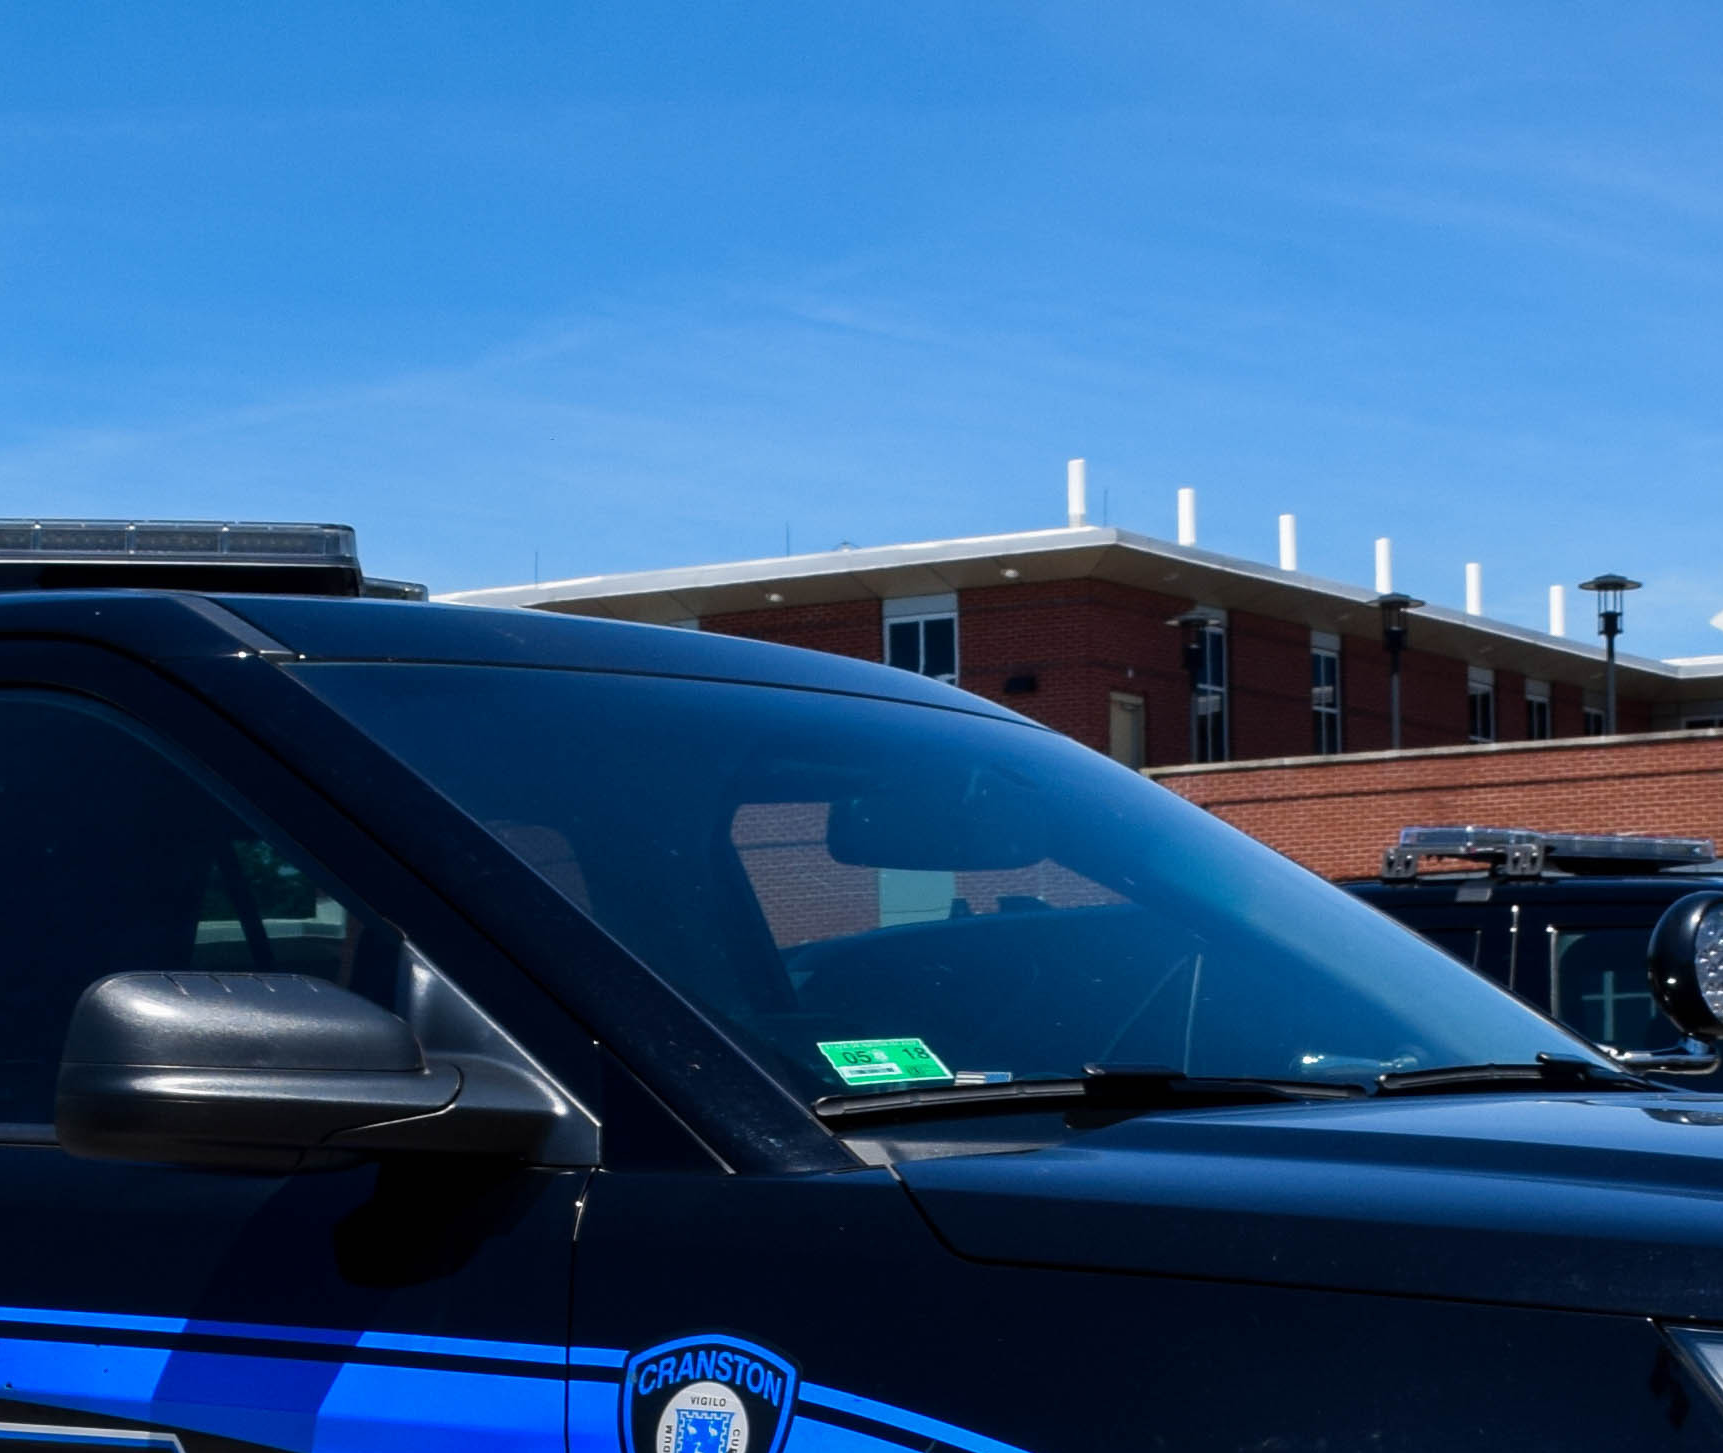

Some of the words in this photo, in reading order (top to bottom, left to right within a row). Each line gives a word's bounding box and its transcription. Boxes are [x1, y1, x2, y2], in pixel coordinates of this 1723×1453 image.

[842, 1050, 872, 1064] 05
[902, 1046, 929, 1060] 18
[638, 1350, 781, 1406] CRANSTON
[663, 1425, 673, 1453] DUM
[690, 1396, 727, 1407] VIGILO
